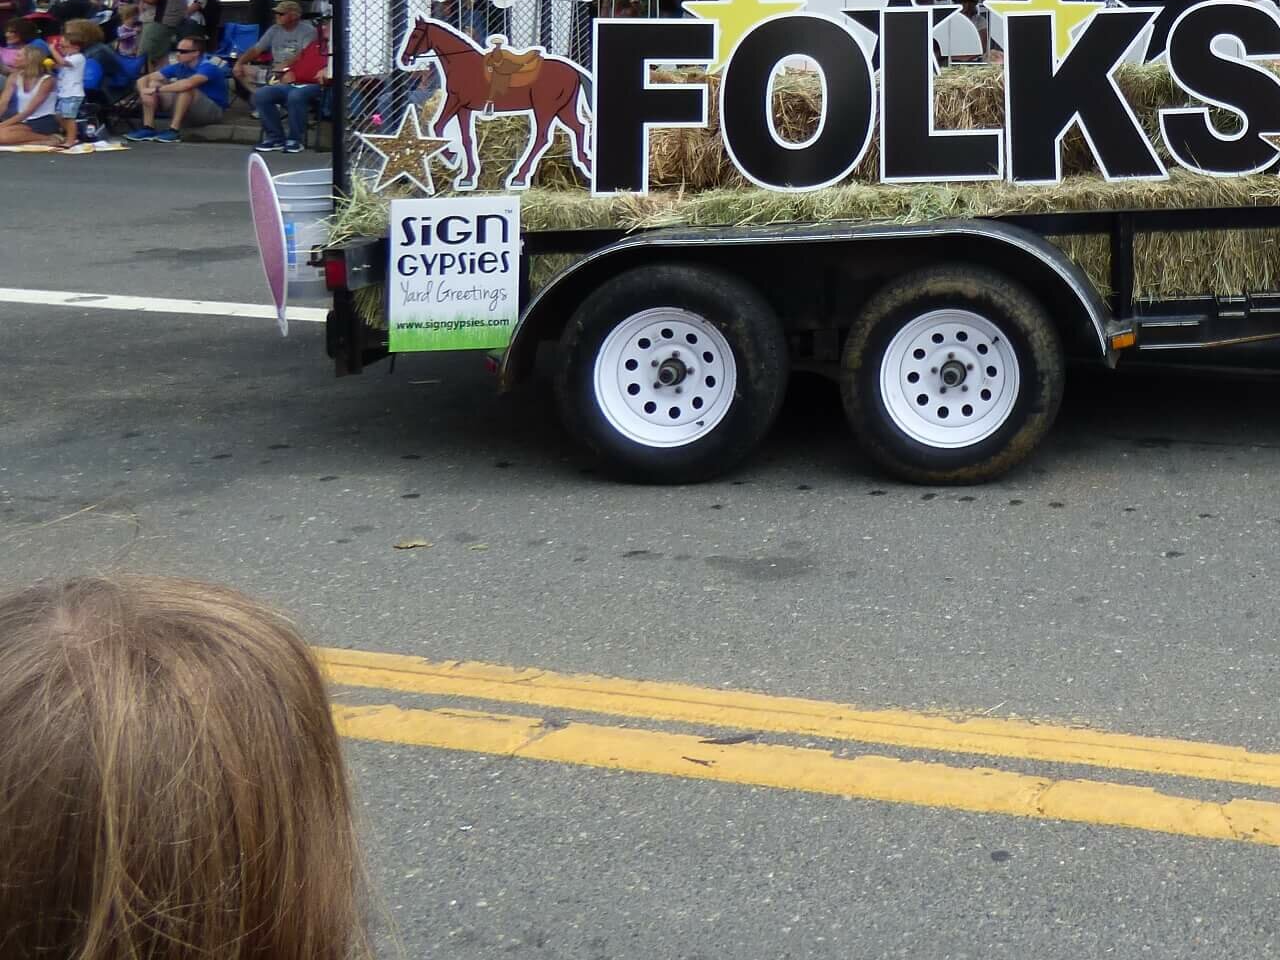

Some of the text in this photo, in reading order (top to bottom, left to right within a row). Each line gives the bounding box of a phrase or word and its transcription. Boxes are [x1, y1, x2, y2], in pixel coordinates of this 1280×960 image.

[400, 280, 508, 311] Yard Greetings
[396, 317, 510, 331] www.signgypsies.com
